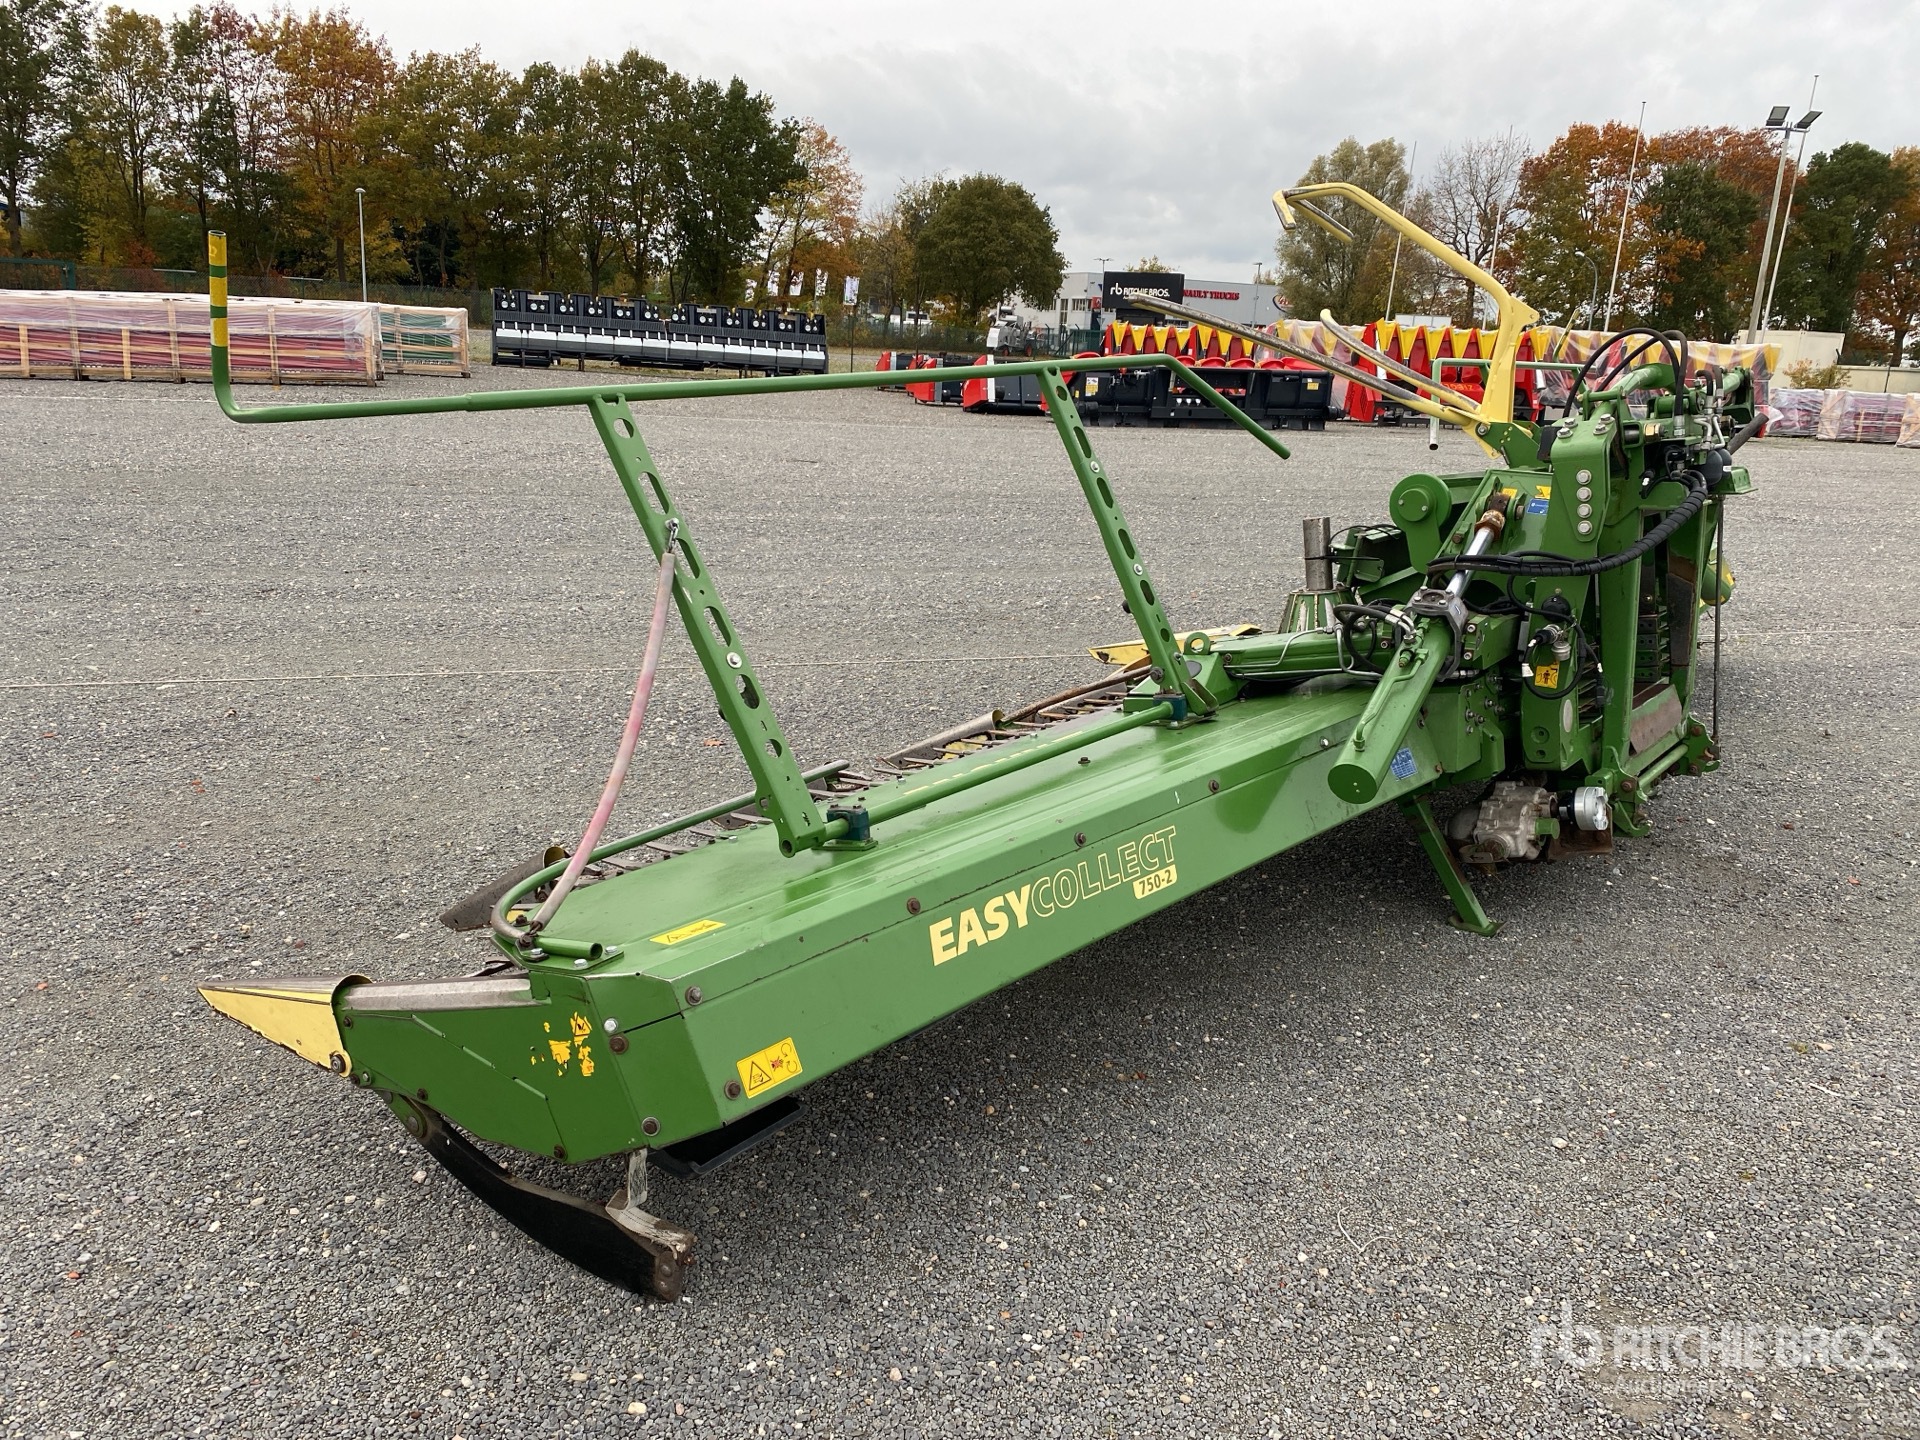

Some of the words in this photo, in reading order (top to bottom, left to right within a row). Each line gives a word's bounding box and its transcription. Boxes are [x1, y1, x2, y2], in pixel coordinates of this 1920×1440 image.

[1110, 283, 1122, 295] rb
[1210, 290, 1240, 301] TRUCKS
[1138, 868, 1173, 896] 750-2
[929, 825, 1177, 966] EASYCOLLECT
